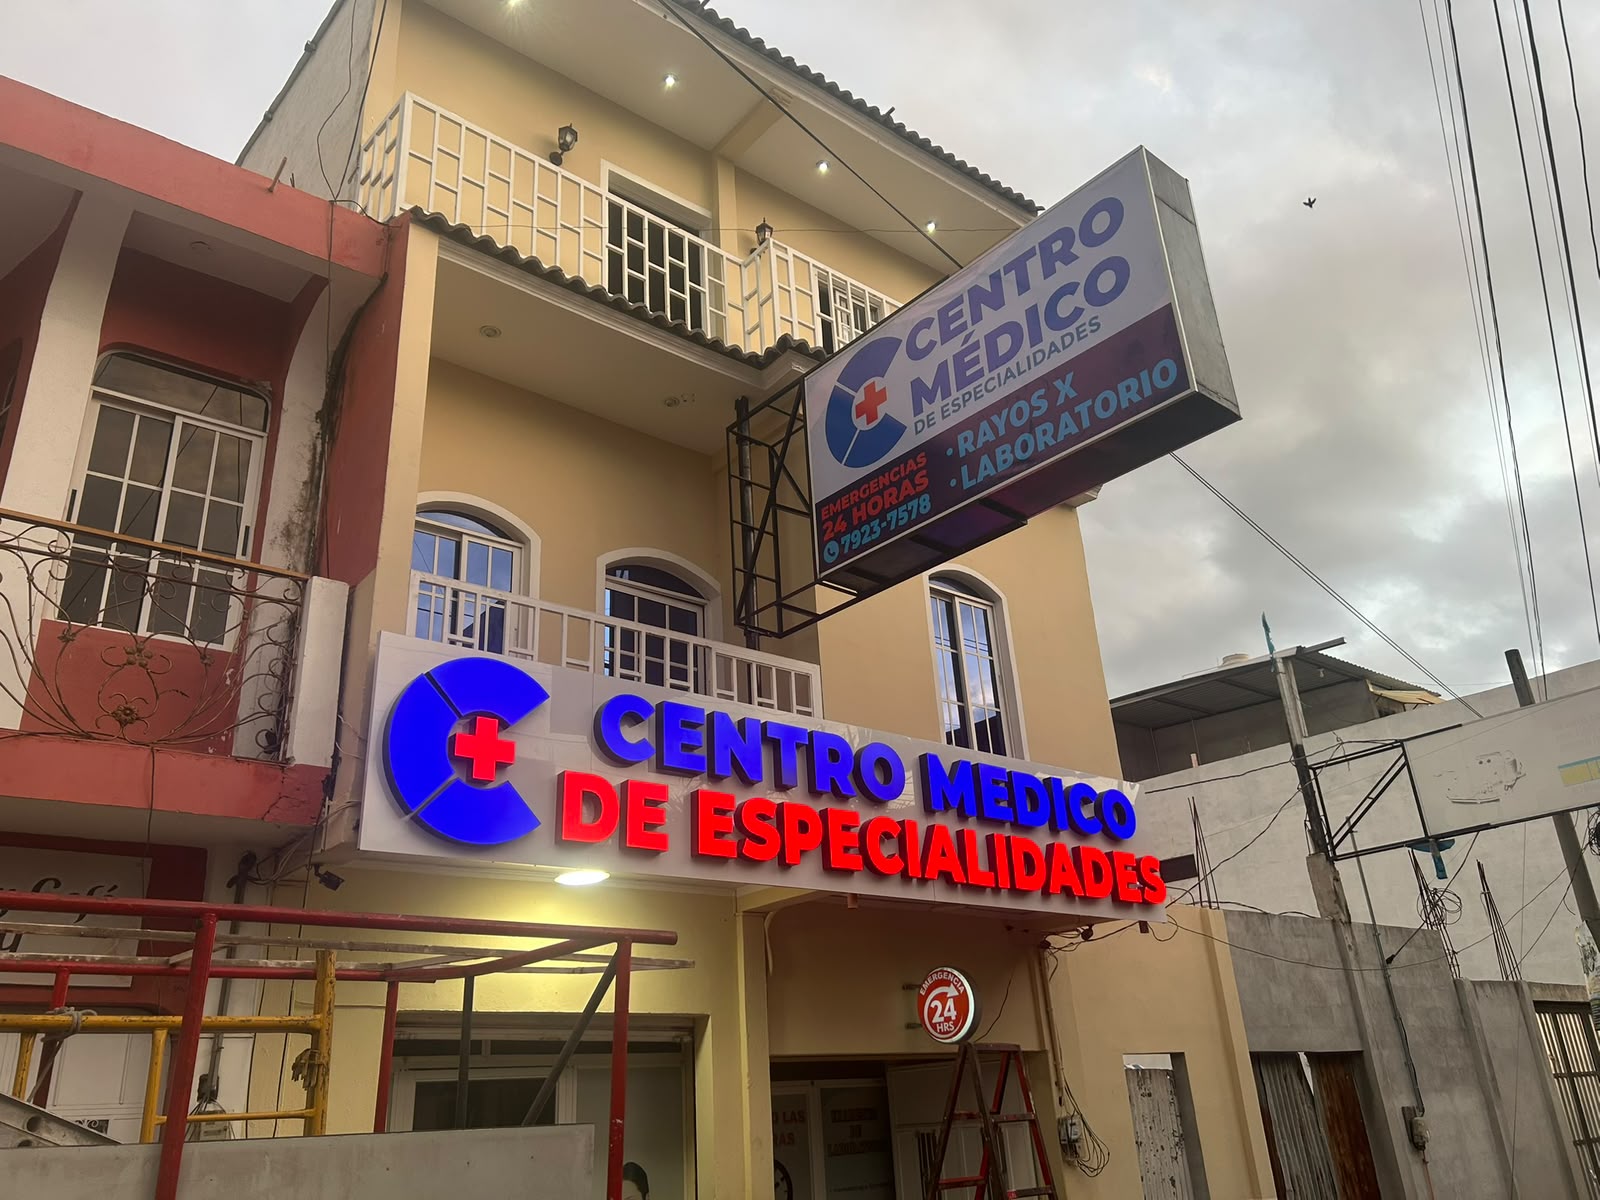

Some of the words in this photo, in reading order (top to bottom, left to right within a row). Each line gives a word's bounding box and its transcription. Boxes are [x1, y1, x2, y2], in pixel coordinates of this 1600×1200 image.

[905, 196, 1125, 362] CENTRO
[910, 255, 1131, 418] MÉDICO
[914, 411, 937, 436] DE
[940, 315, 1102, 420] ESPECIALIDADES
[957, 388, 1049, 458] RAYOS
[1052, 371, 1078, 406] X
[960, 358, 1178, 490] LABORATORIO
[821, 451, 928, 521] EMERGENCIAS
[823, 514, 848, 541] 24
[851, 469, 929, 526] HORAS
[841, 493, 932, 554] 7923-7578
[595, 694, 906, 802] CENTRO
[919, 752, 1137, 840] MEDICO
[557, 770, 670, 852] DE
[691, 788, 1168, 905] ESPECIALIDADES
[920, 971, 965, 996] EMERGENCIA
[930, 998, 957, 1023] 24
[936, 1021, 955, 1033] HRS
